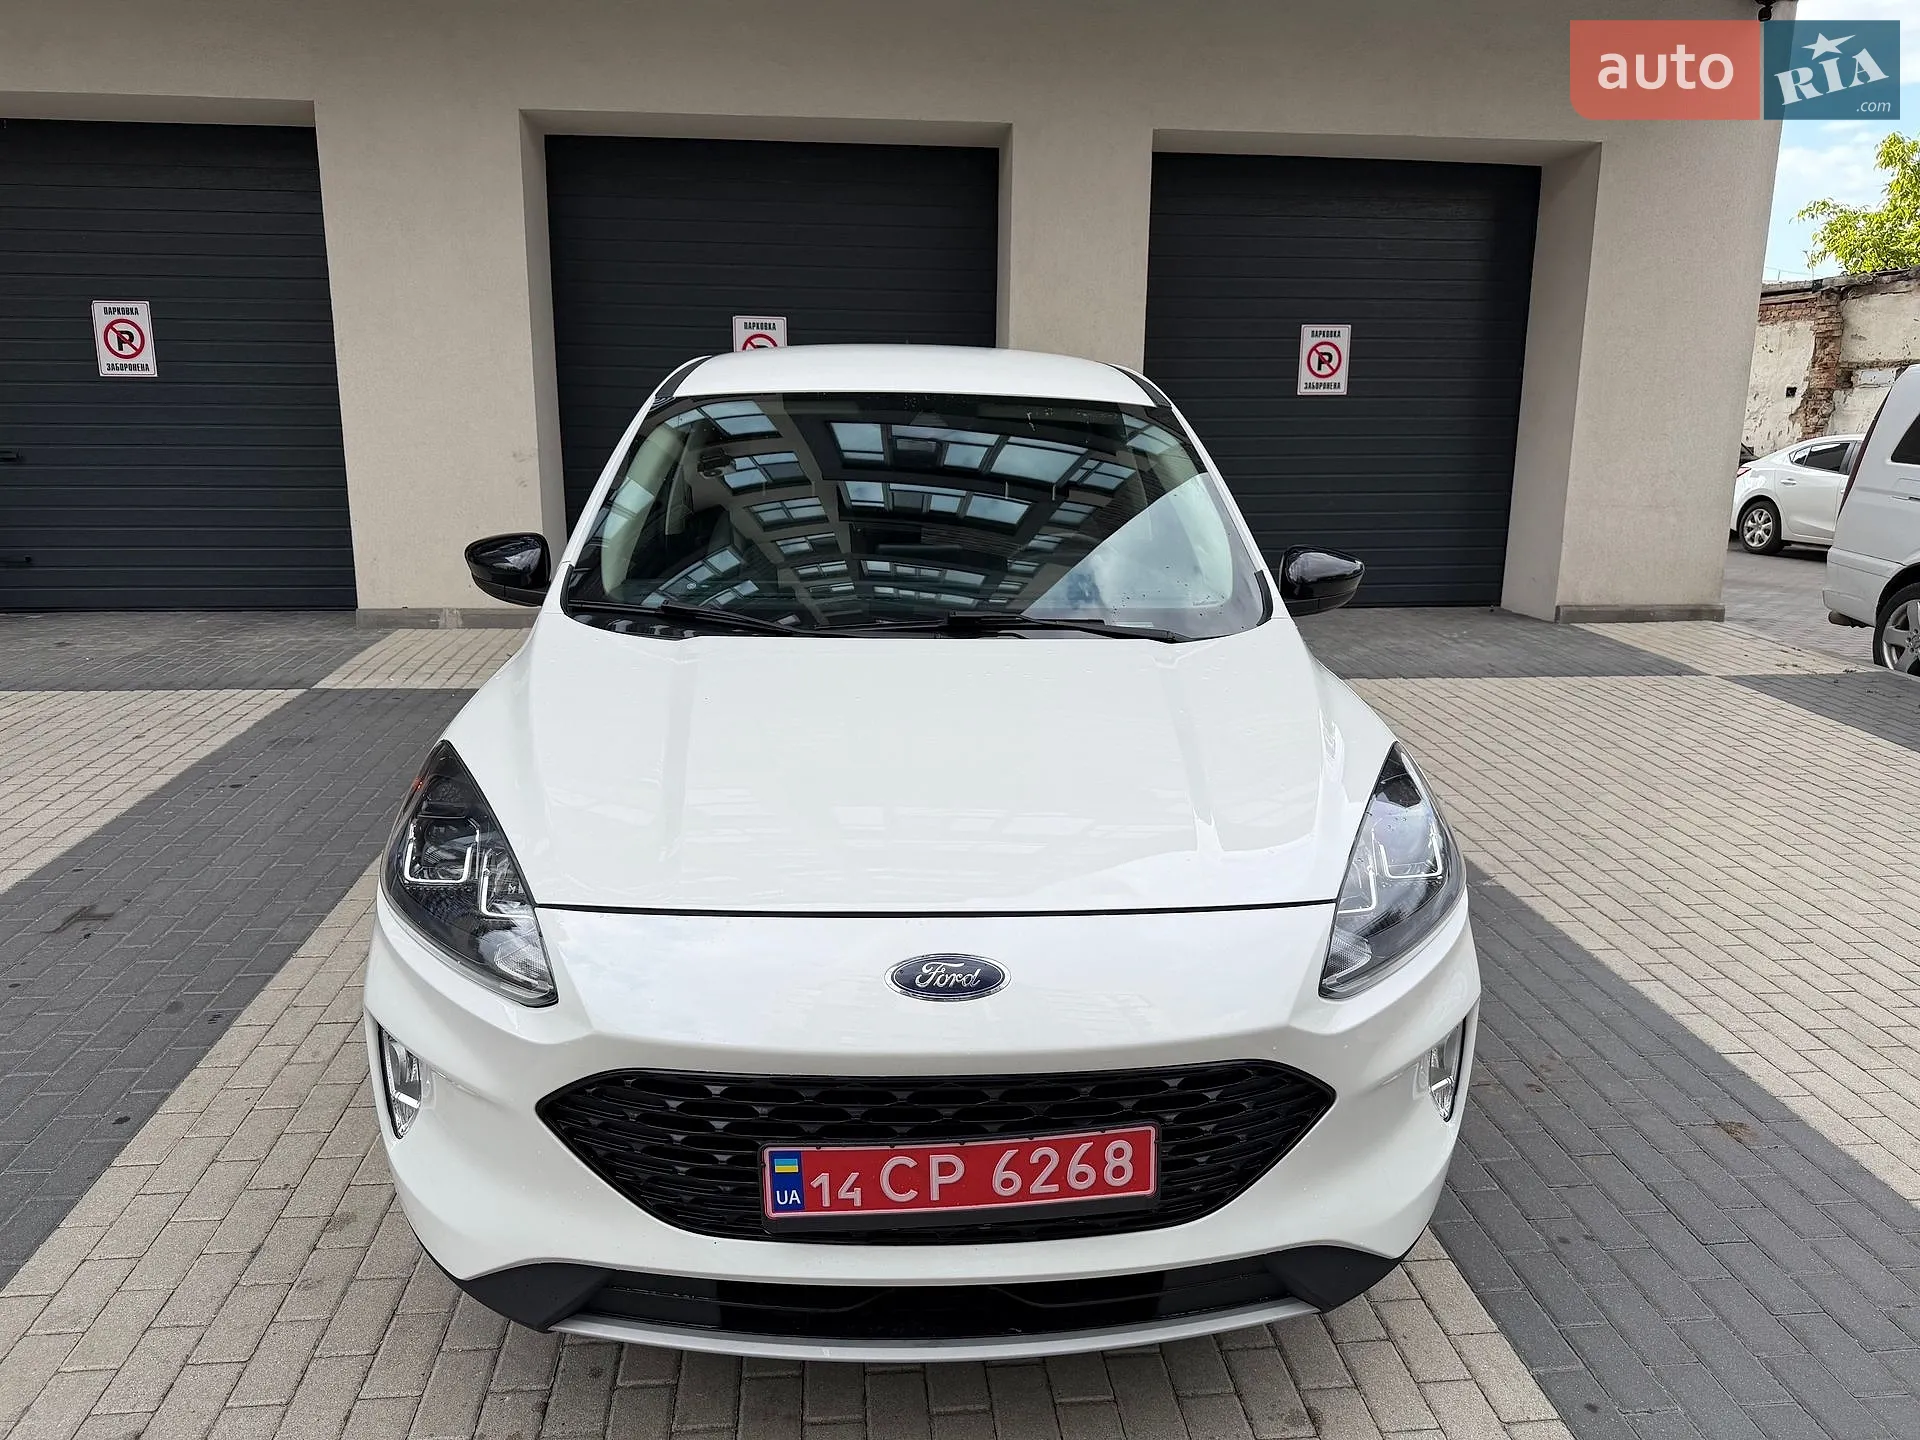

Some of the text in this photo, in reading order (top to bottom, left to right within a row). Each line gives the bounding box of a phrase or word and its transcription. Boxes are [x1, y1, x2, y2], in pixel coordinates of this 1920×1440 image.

[103, 306, 140, 316] ПАРКОВКА
[1311, 330, 1341, 338] ПАРКОВКА
[106, 362, 150, 372] ЗАБОРОНЕНА
[1303, 382, 1341, 390] ЗАБОРОНЕНА
[914, 961, 982, 988] Ford
[810, 1172, 863, 1207] 14
[992, 1139, 1134, 1197] 6268
[776, 1190, 801, 1205] UA
